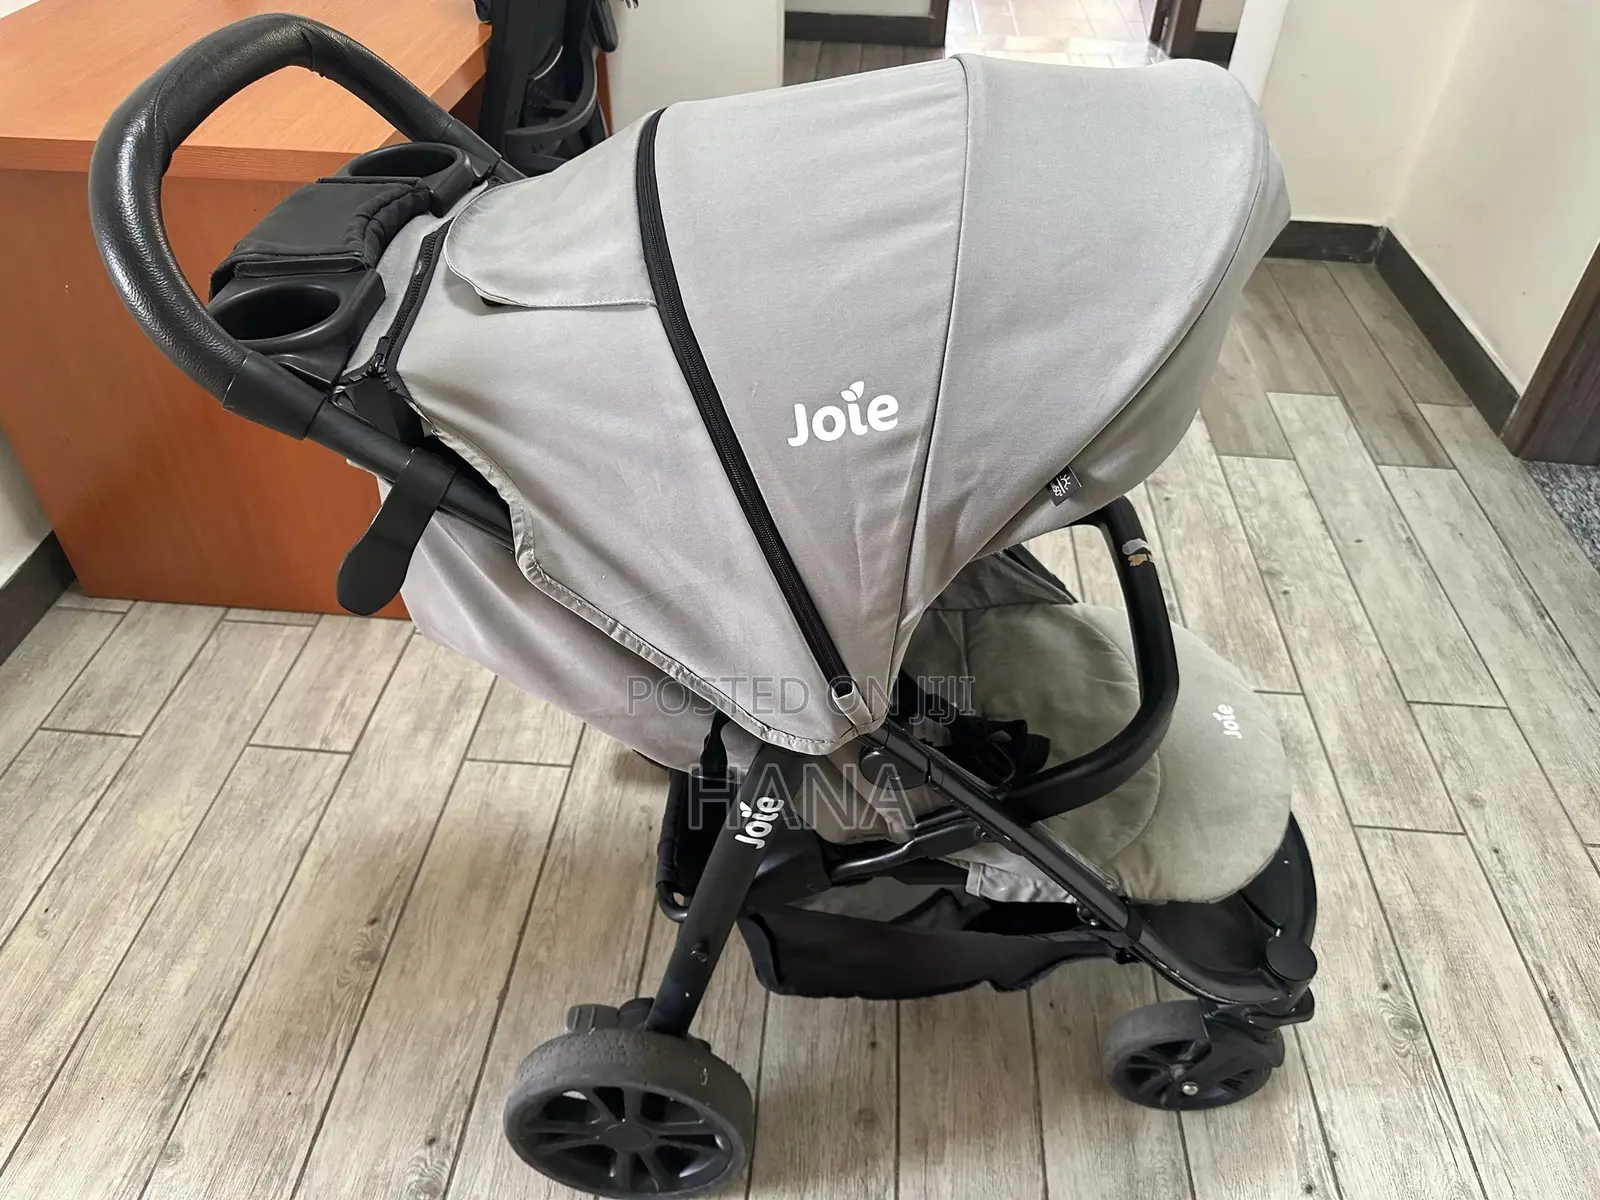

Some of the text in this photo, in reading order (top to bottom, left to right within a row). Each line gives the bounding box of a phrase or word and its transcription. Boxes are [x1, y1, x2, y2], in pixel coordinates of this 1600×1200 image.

[787, 380, 899, 447] Joie
[1212, 704, 1243, 739] Joie
[734, 796, 785, 850] Joie
